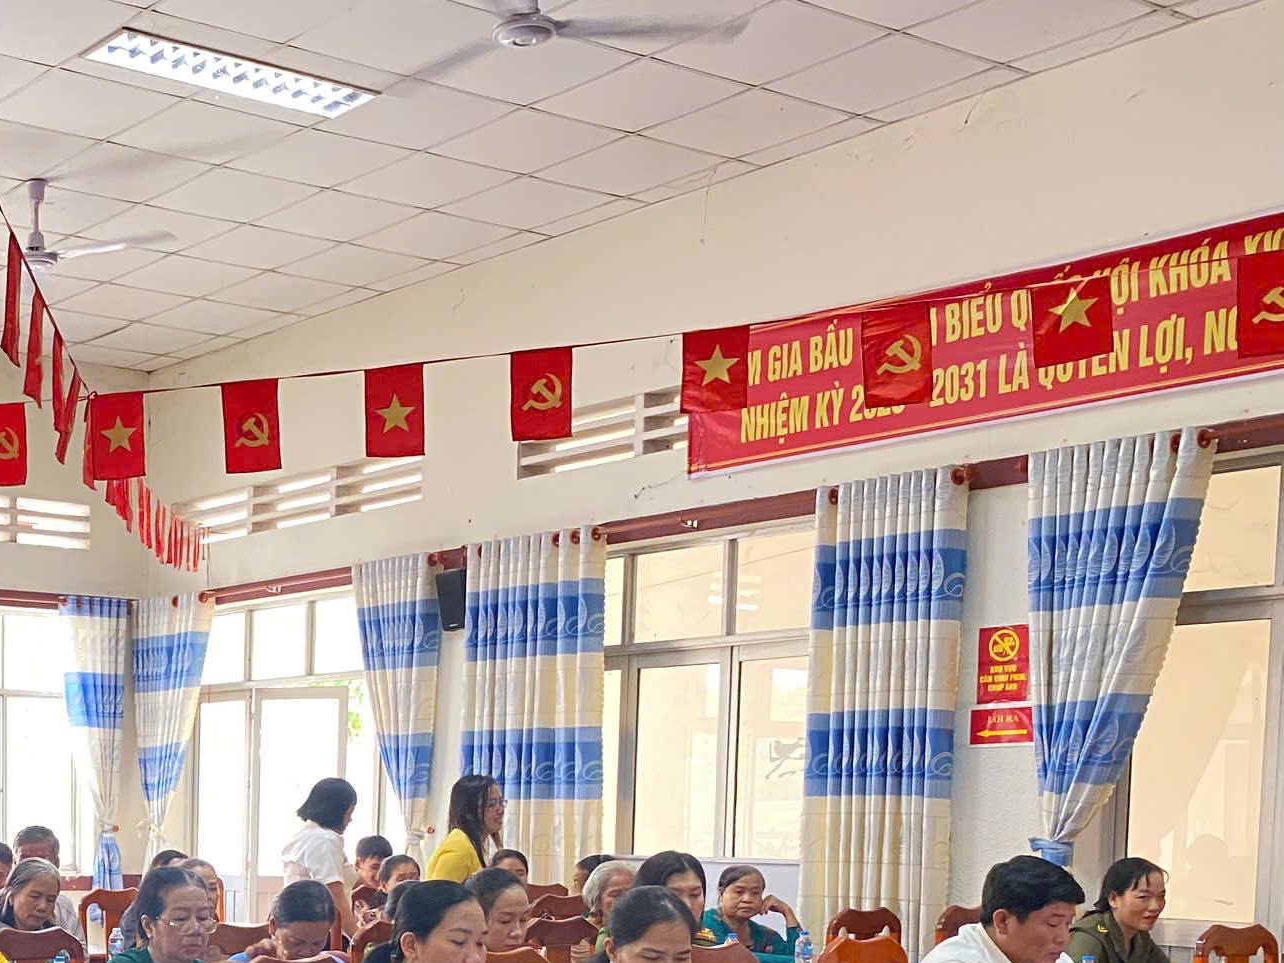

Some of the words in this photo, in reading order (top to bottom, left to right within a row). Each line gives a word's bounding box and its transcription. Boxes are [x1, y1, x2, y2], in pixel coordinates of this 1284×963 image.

[767, 340, 803, 382] GIA
[1149, 237, 1232, 298] KHÓA
[740, 392, 810, 444] NHIỆM
[815, 381, 845, 430] KỲ
[929, 358, 988, 407] 2031
[998, 341, 1030, 394] LÀ
[1139, 314, 1193, 374] LỢI,
